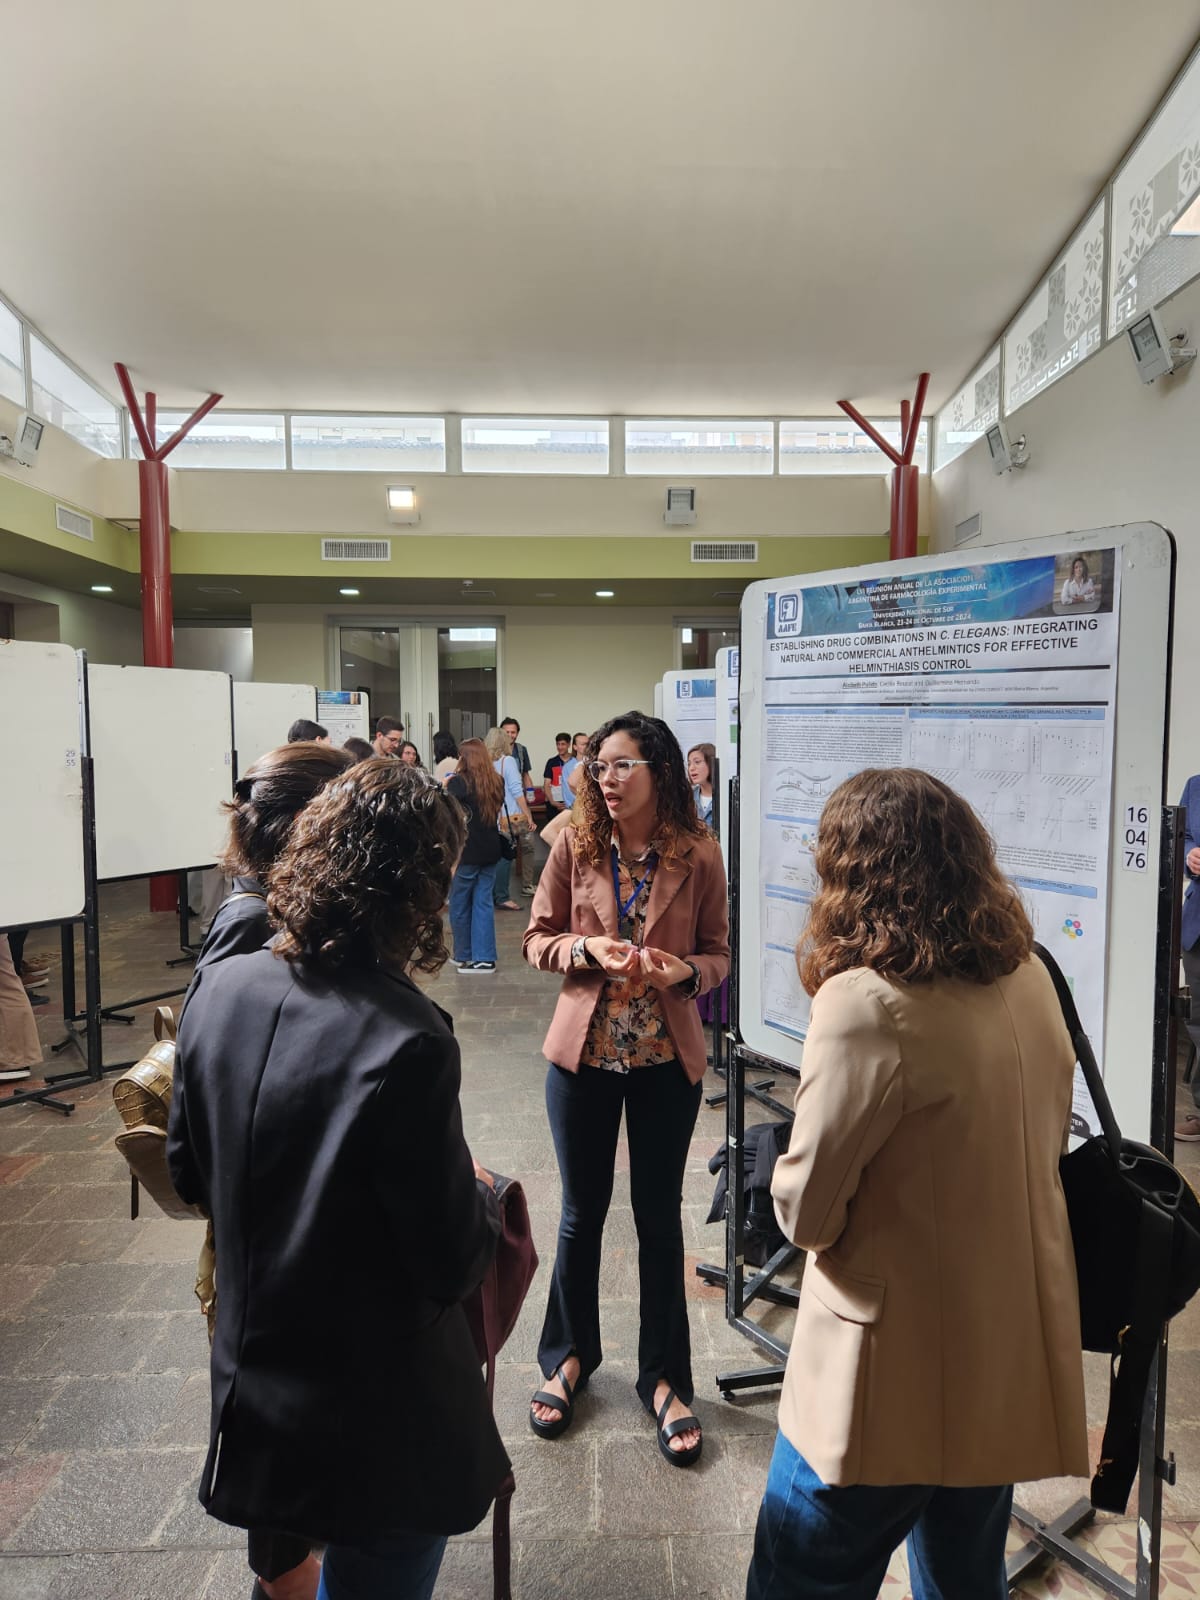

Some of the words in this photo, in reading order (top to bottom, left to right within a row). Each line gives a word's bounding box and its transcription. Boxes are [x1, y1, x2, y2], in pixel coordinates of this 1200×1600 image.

[866, 583, 892, 593] REUNIÓN
[894, 581, 914, 591] ANUAL
[924, 579, 933, 587] LA
[881, 593, 889, 601] DE
[938, 583, 988, 595] EXPERIMENTAL
[770, 639, 825, 652] ESTABLISHING
[827, 637, 852, 648] DRUG
[853, 632, 925, 646] COMBINATIONS
[927, 631, 937, 641] IN
[940, 630, 950, 640] C.
[953, 626, 1010, 640] ELEGANS:
[1013, 618, 1098, 636] INTEGRATING
[778, 623, 798, 633] AAFE
[780, 652, 816, 663] NATURAL
[817, 652, 835, 662] AND
[836, 647, 897, 661] COMMERCIAL
[899, 643, 981, 657] ANTHELMINTICS
[984, 641, 1008, 653] FOR
[1011, 637, 1079, 652] EFFECTIVE
[849, 660, 920, 673] HELMINTHIASIS
[922, 658, 972, 671] CONTROL
[1127, 806, 1148, 824] 16
[1125, 828, 1147, 846] 04
[1125, 851, 1146, 869] 76
